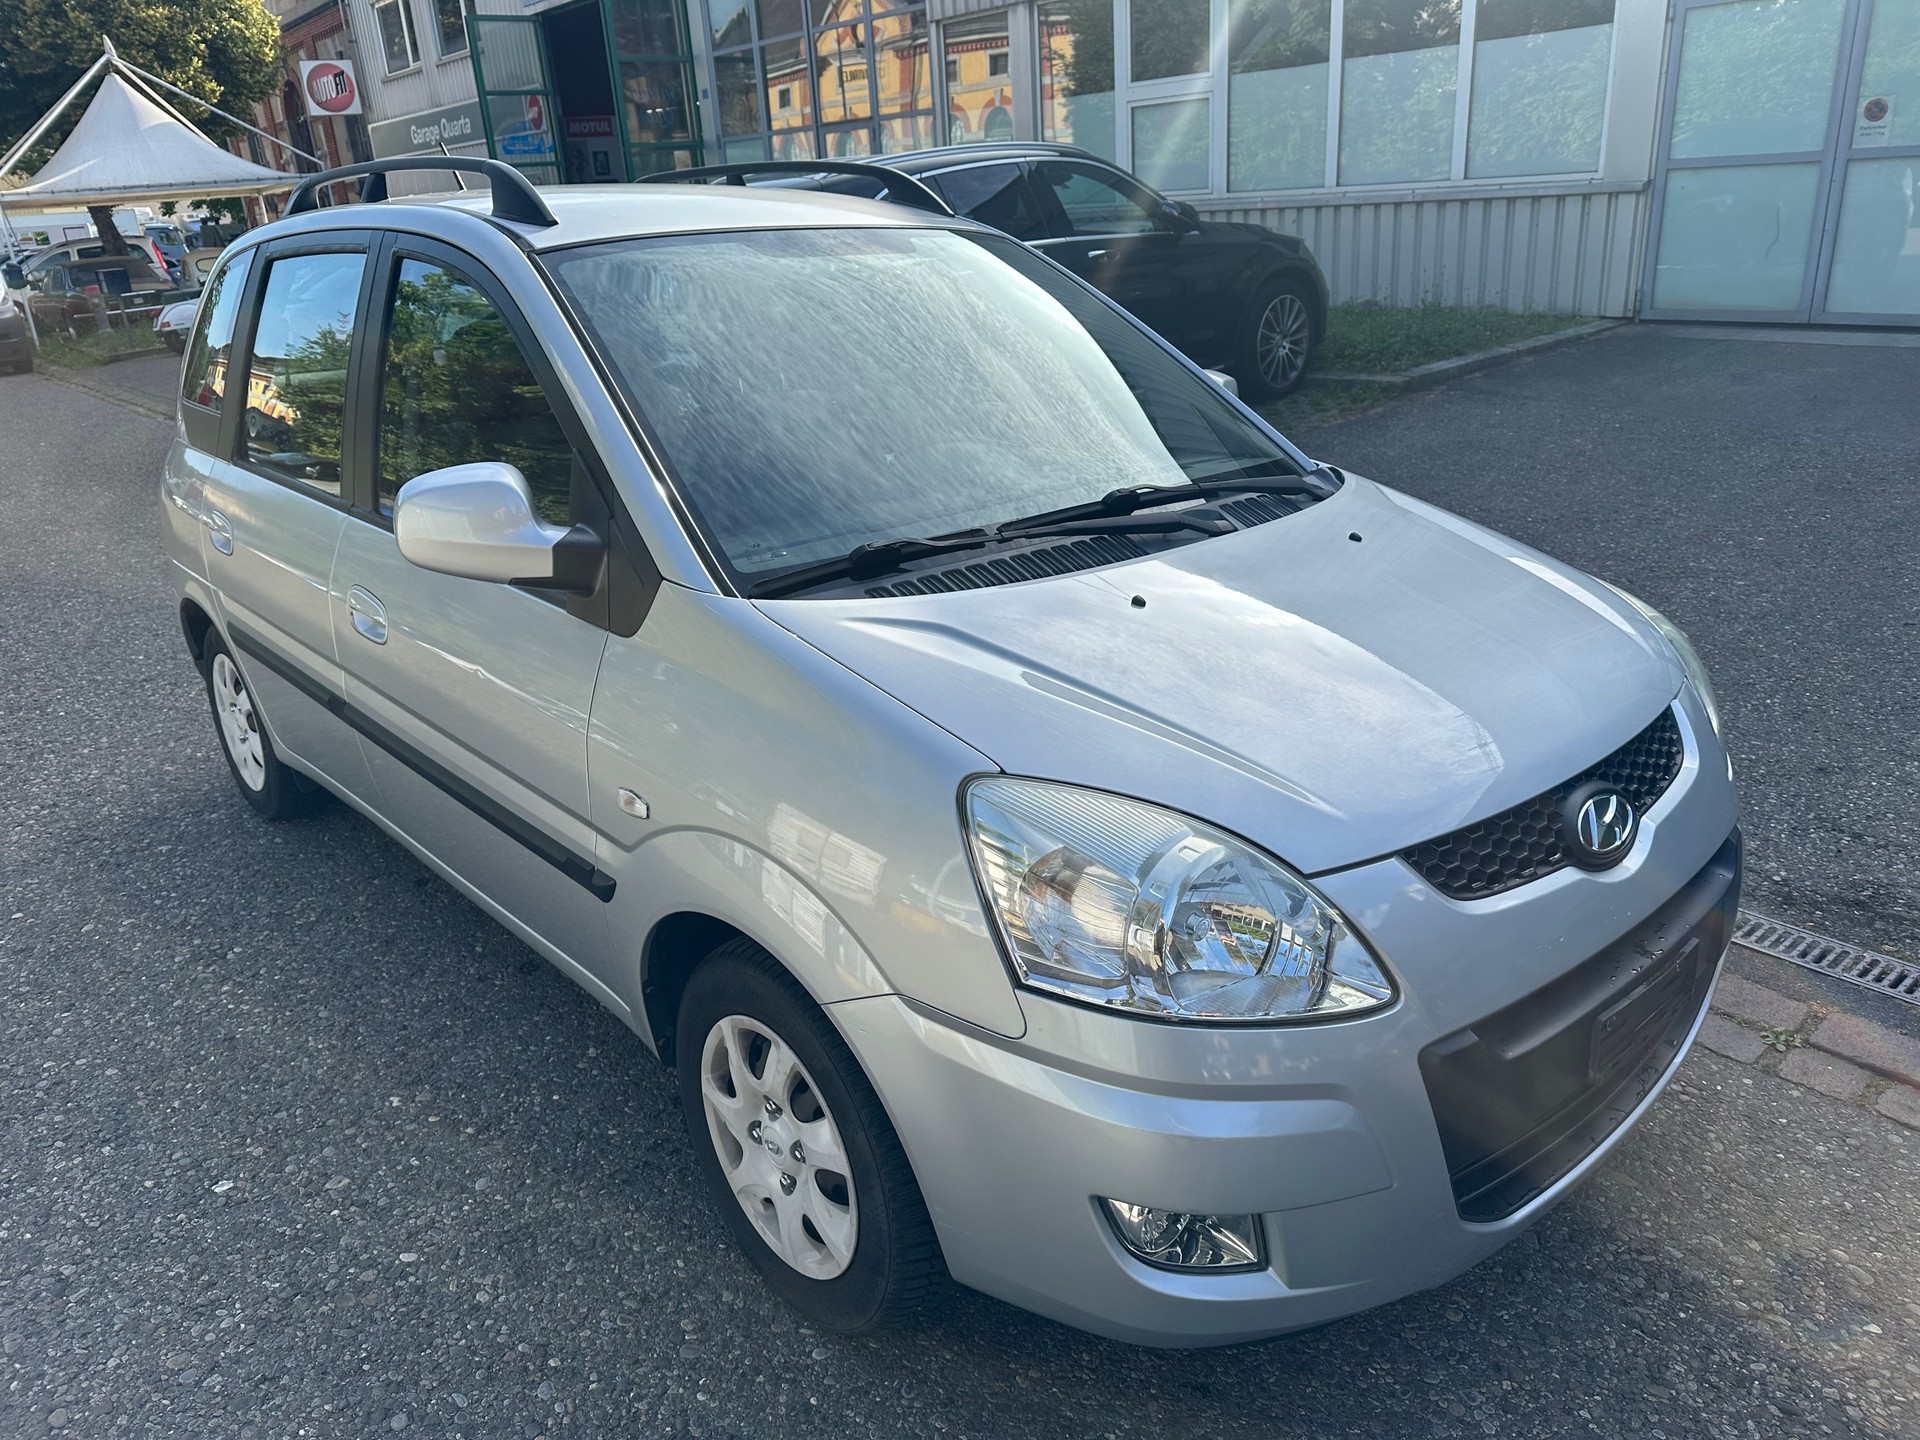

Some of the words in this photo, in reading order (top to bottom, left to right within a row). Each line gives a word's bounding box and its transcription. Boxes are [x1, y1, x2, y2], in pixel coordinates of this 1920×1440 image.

[410, 124, 440, 145] Garage
[440, 114, 471, 138] Quarta
[568, 120, 611, 134] MOTUL
